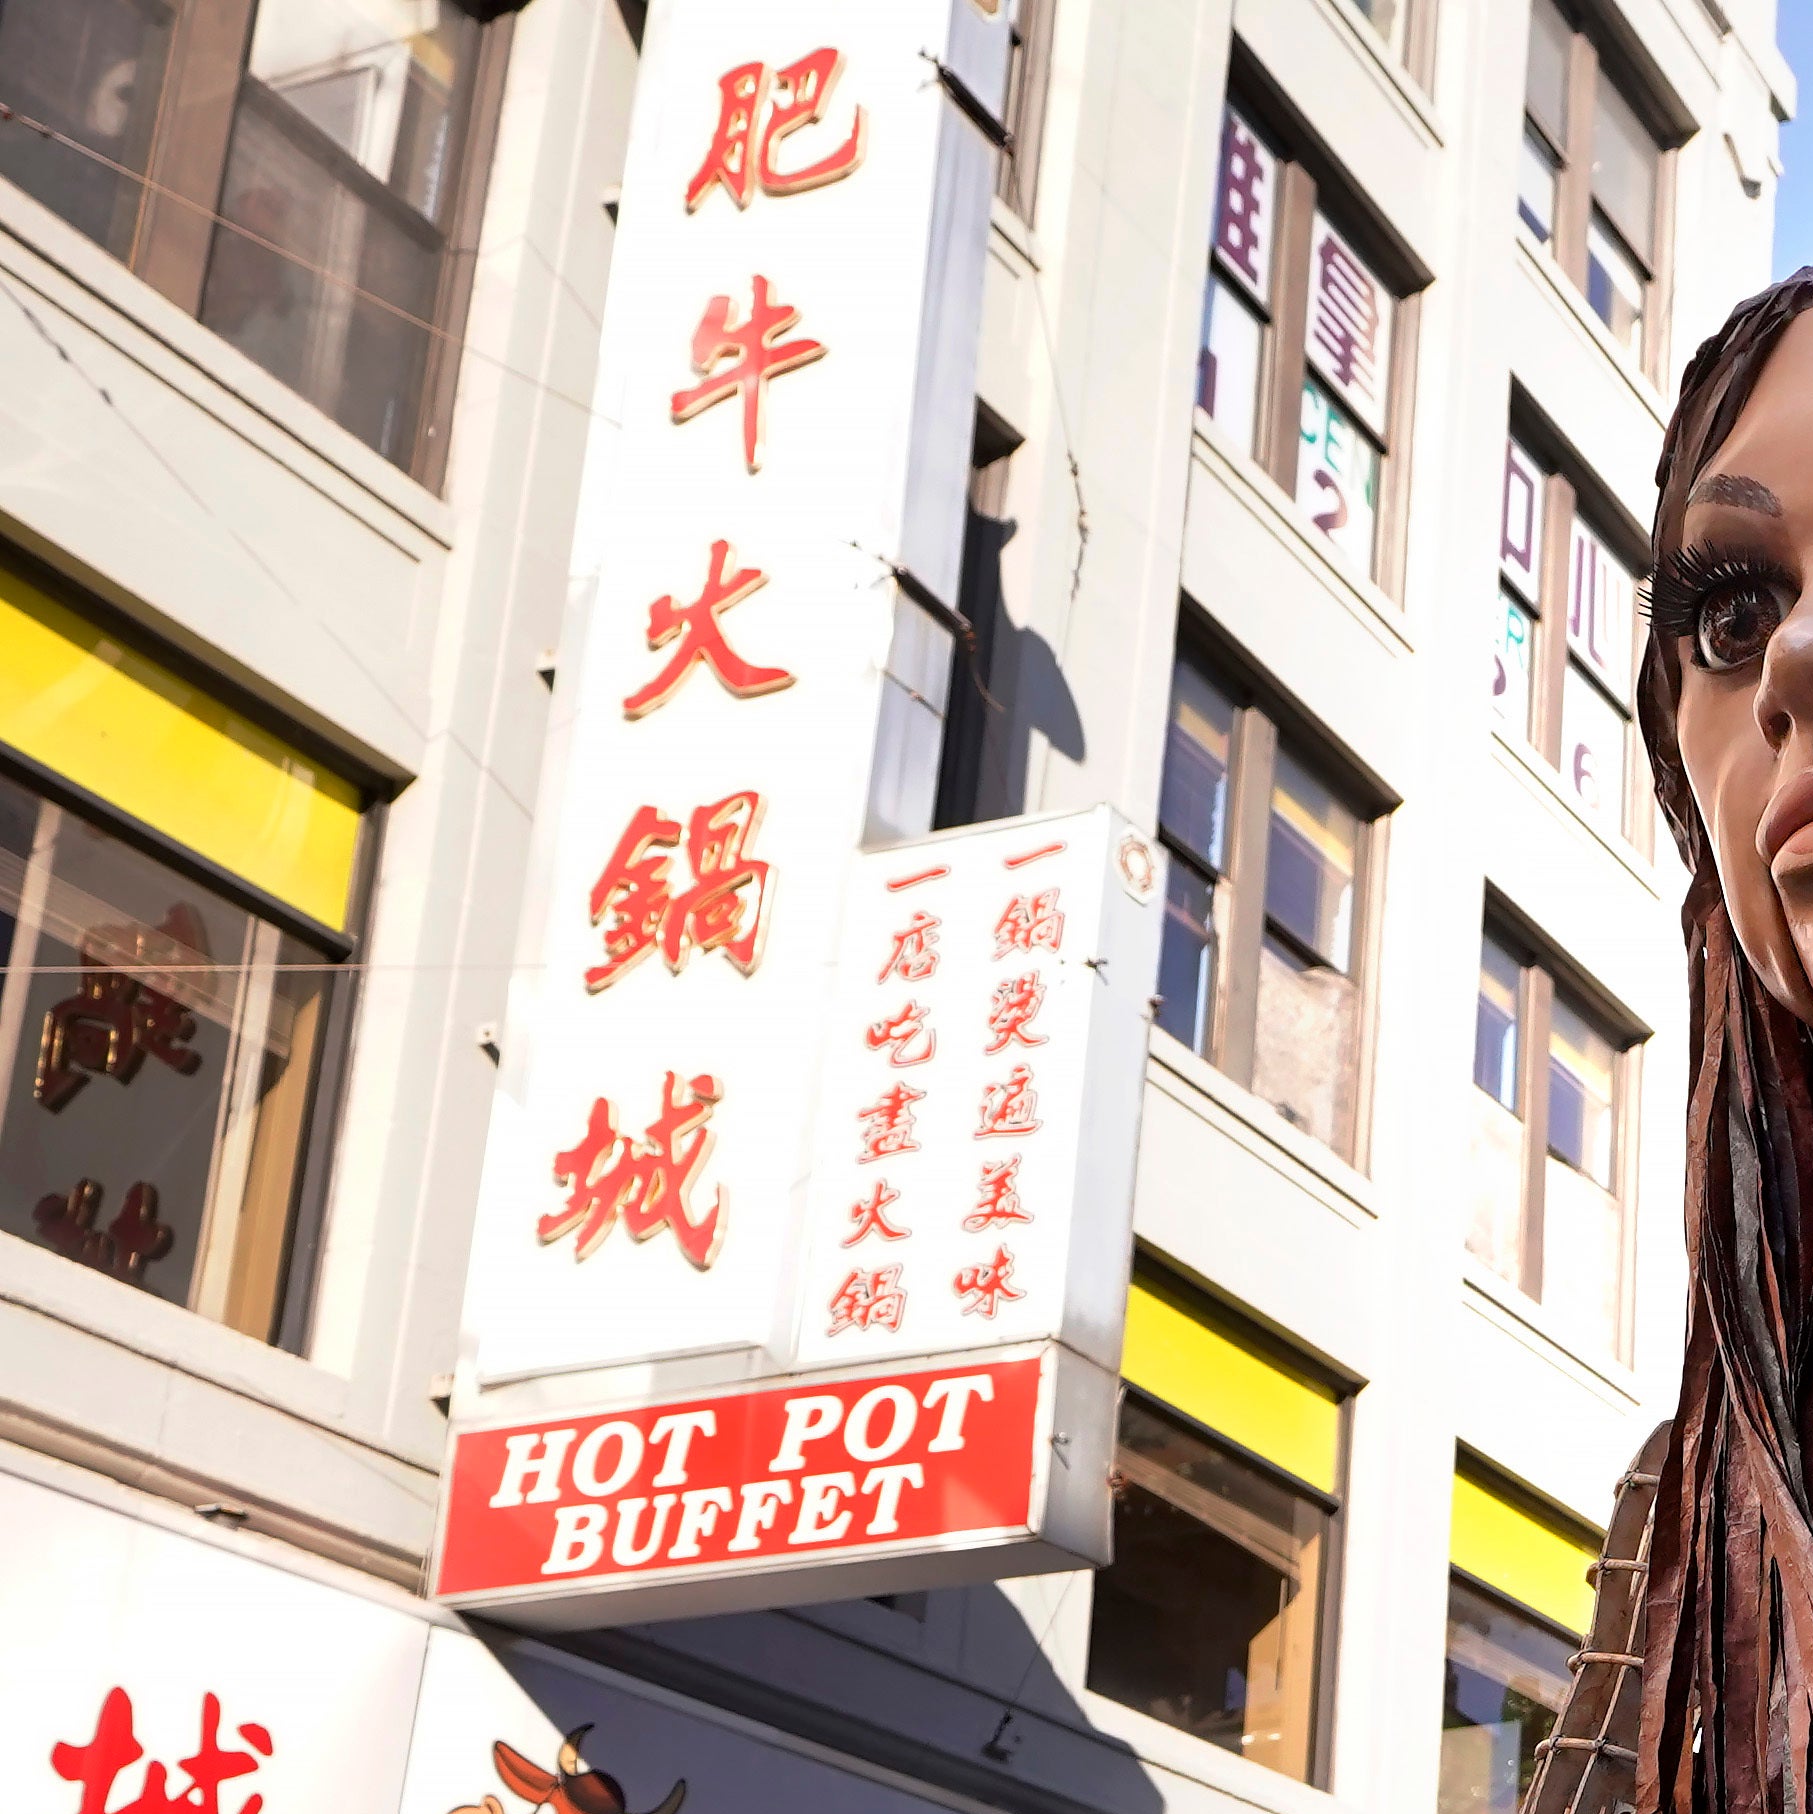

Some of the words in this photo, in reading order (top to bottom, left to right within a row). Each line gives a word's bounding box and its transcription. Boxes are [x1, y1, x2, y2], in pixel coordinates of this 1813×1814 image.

[537, 47, 868, 1272] 肥牛火鍋城
[489, 1410, 717, 1508] HOT
[768, 1373, 995, 1472] POT
[541, 1463, 925, 1575] BUFFET
